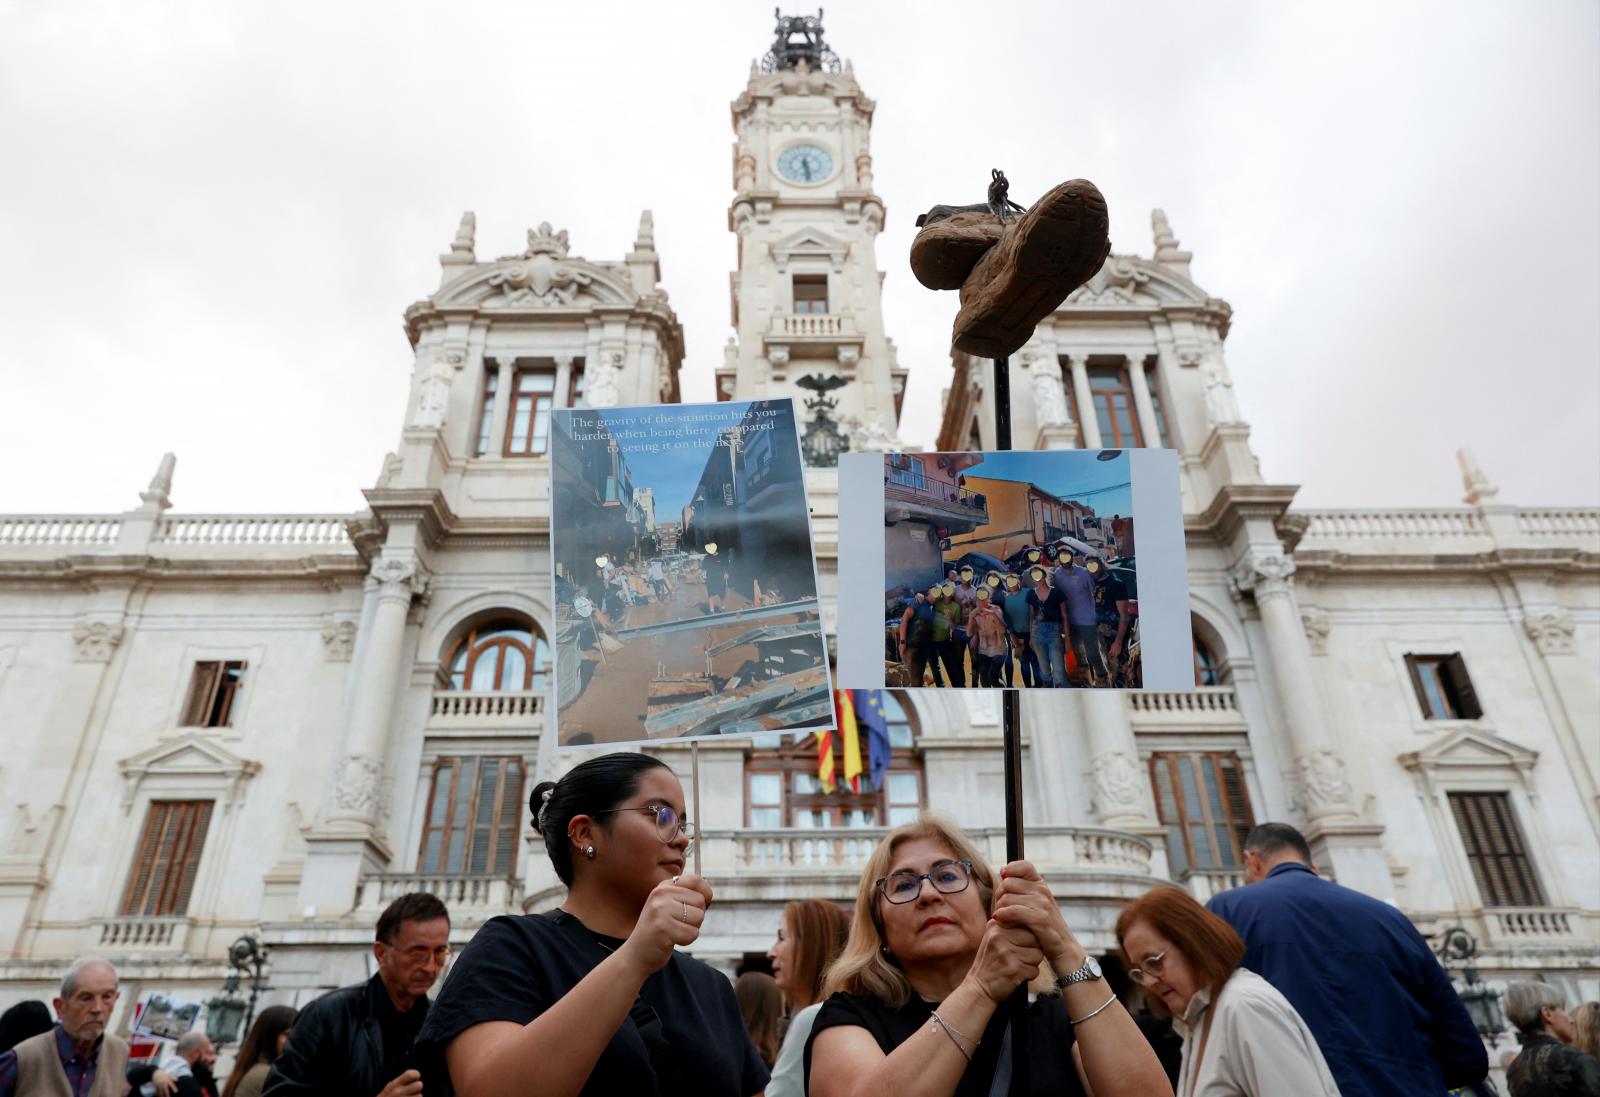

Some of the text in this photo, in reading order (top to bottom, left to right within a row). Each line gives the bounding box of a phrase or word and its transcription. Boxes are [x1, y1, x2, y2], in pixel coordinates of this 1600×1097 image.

[571, 409, 777, 429] The gravity of the situation hits you
[574, 431, 612, 441] harder
[616, 429, 647, 439] when
[650, 427, 682, 438] being
[717, 420, 774, 434] compared
[607, 445, 619, 453] to
[623, 443, 659, 453] seeing
[662, 441, 671, 450] it
[674, 441, 689, 449] on
[693, 438, 712, 448] the
